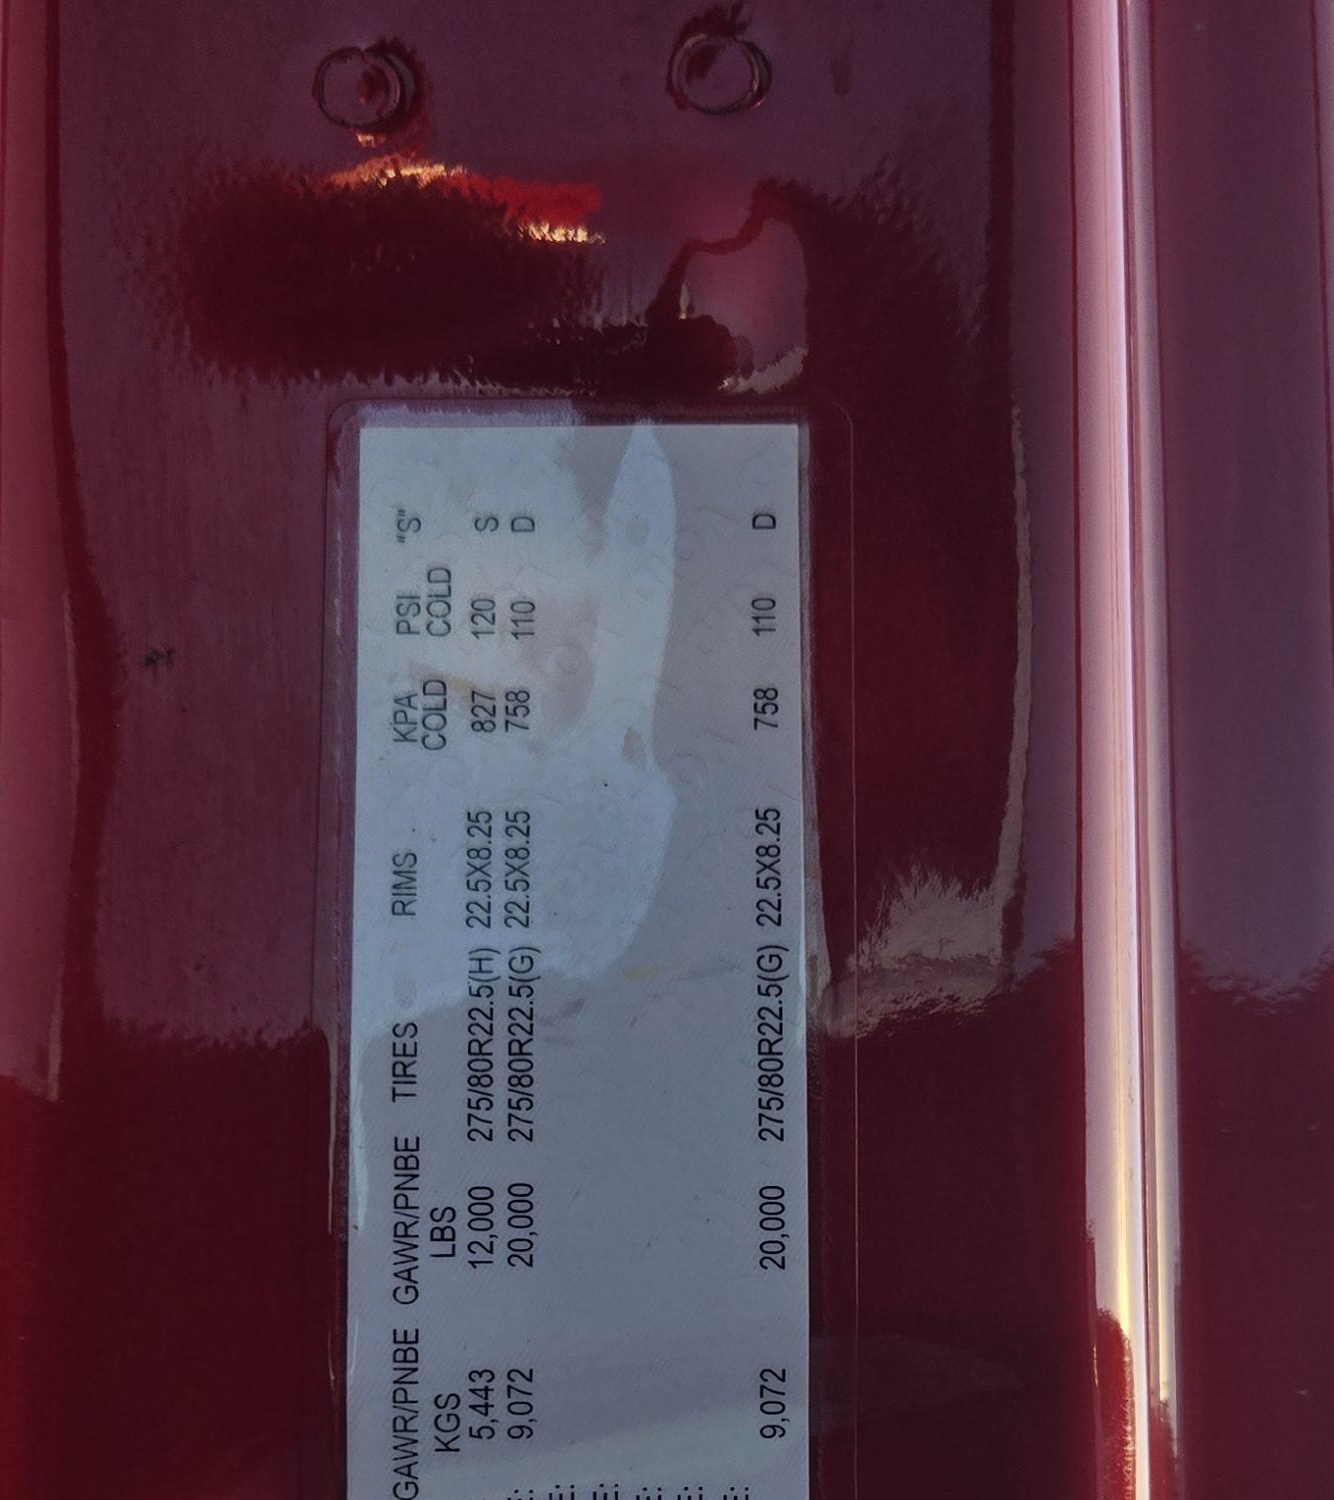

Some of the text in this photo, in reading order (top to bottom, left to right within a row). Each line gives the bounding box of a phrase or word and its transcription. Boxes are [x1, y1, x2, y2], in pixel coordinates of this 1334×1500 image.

[474, 516, 499, 532] S
[511, 516, 535, 532] D
[752, 512, 776, 530] D
[470, 598, 496, 639] 120
[510, 601, 535, 640] 110
[751, 596, 776, 636] 110
[471, 687, 496, 733] 827
[505, 689, 530, 732] 758
[753, 687, 779, 731] 758
[465, 811, 492, 929] 22.5X8.25
[504, 811, 530, 928] 22.5X8.25
[755, 807, 782, 927] 22.5X8.25
[391, 509, 421, 1500] GAWR/PNBE GAWR/PNBE TIRES RIMS KPA PSI "S"
[421, 567, 461, 1452] KGS LBS COLD COLD
[467, 948, 501, 1142] 275/80R22.5(H)
[507, 946, 541, 1142] 275/80R22.5(G)
[756, 945, 789, 1142] 275/80R22.5(G)
[467, 1186, 498, 1269] 12,000
[507, 1183, 538, 1267] 20,000
[759, 1186, 790, 1270] 20,000
[468, 1369, 499, 1440] 5,443
[507, 1368, 538, 1439] 9,072
[759, 1368, 790, 1439] 9,072
